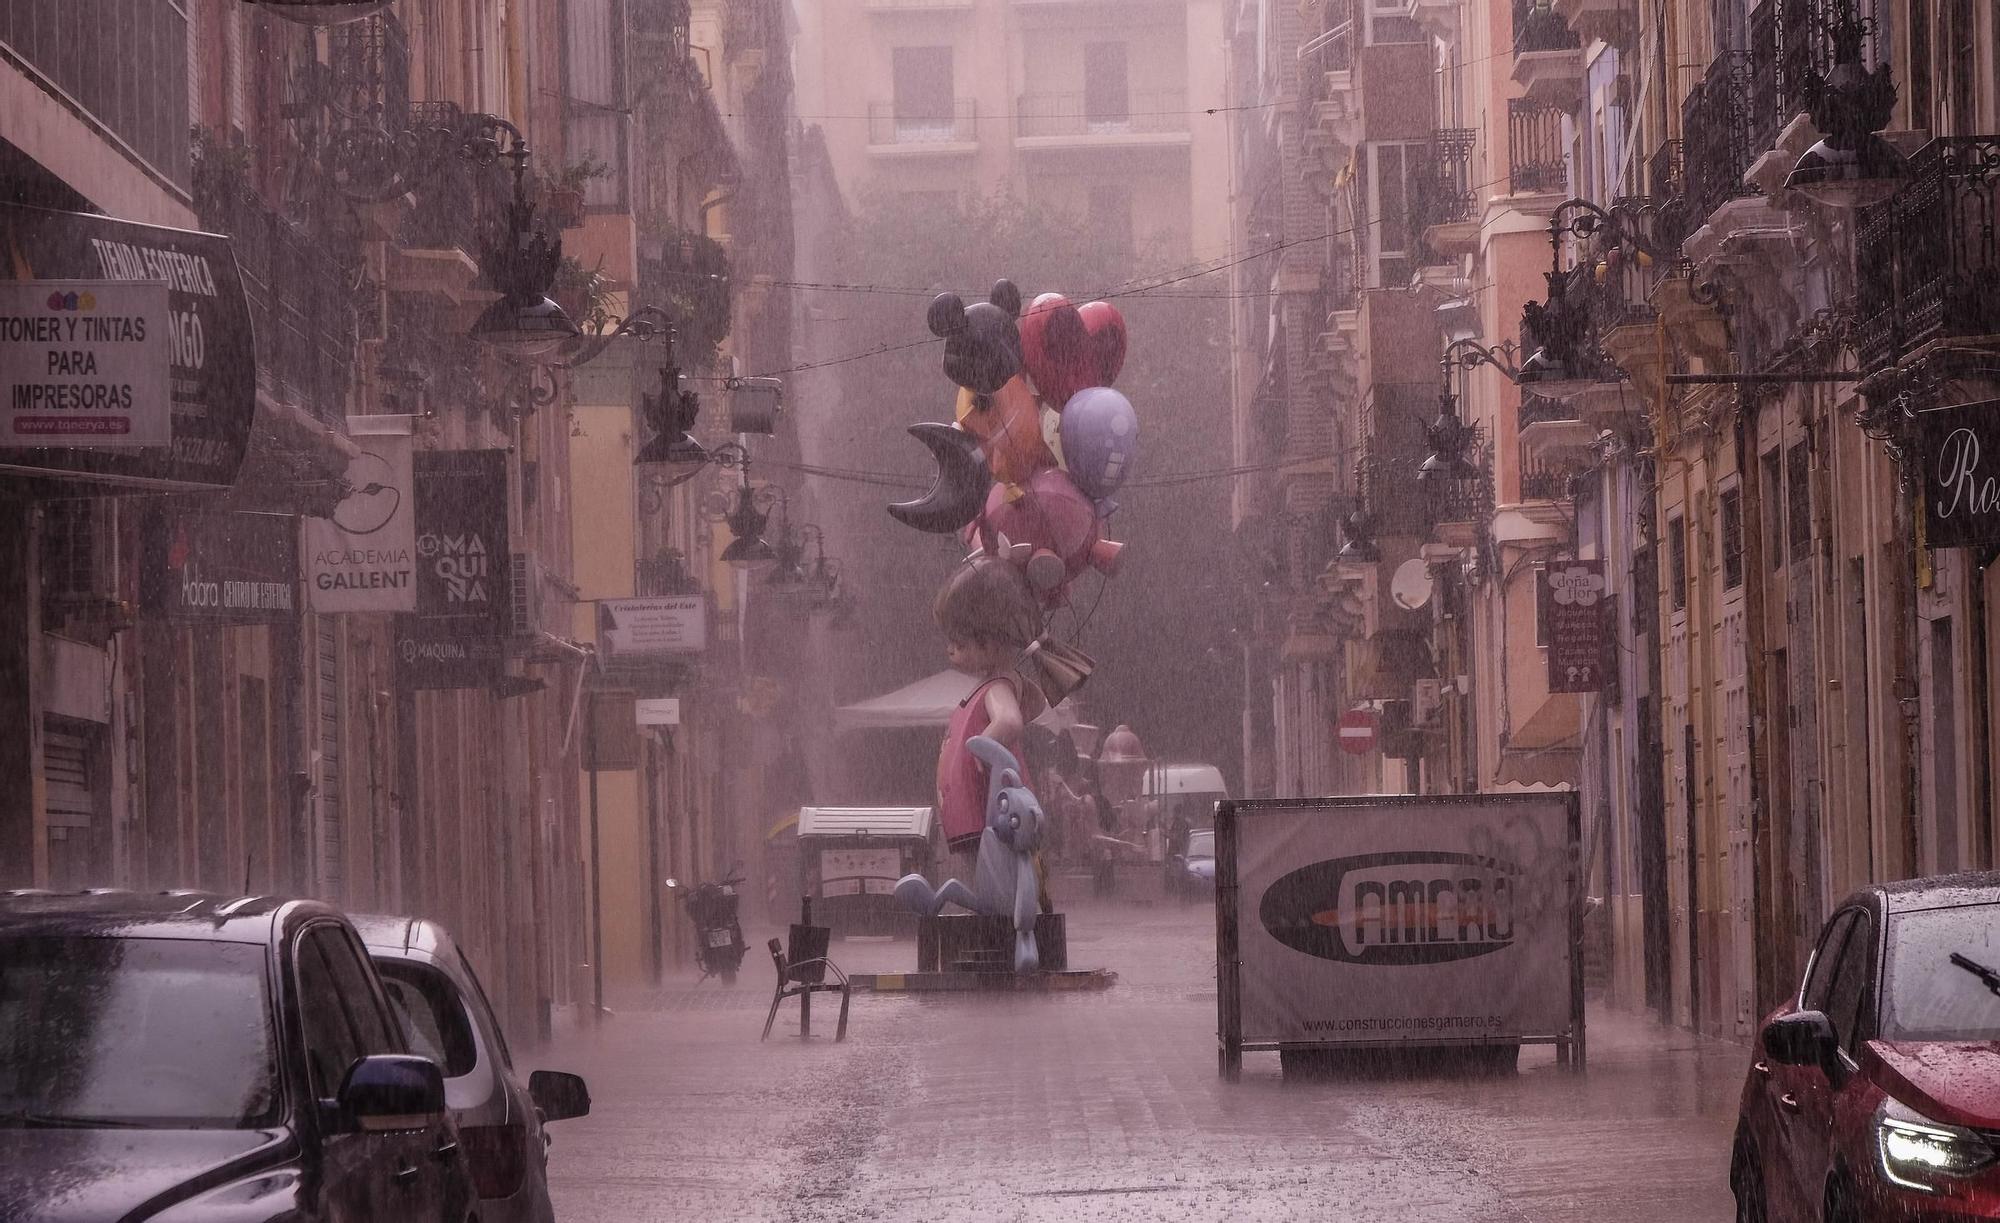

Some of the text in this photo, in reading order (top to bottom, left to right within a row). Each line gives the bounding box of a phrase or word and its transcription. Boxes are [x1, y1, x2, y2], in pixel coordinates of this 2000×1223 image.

[91, 238, 217, 296] TIENDA ESOTÉRICA
[0, 317, 146, 342] TONER Y TINTAS
[168, 302, 205, 369] NGÓ
[48, 351, 97, 375] PARA
[12, 384, 133, 409] IMPRESORAS
[20, 420, 123, 432] www.tonerya.es
[443, 533, 487, 555] MA
[315, 549, 410, 566] ACADEMIA
[436, 556, 487, 580] QUI
[316, 570, 411, 590] GALLENT
[447, 579, 487, 602] NA
[1557, 575, 1589, 588] doña
[223, 580, 250, 608] CENTRO
[251, 582, 261, 608] DE
[1568, 587, 1592, 599] flor
[664, 602, 678, 611] del
[1302, 1015, 1502, 1032] www.construccionesgamero.es
